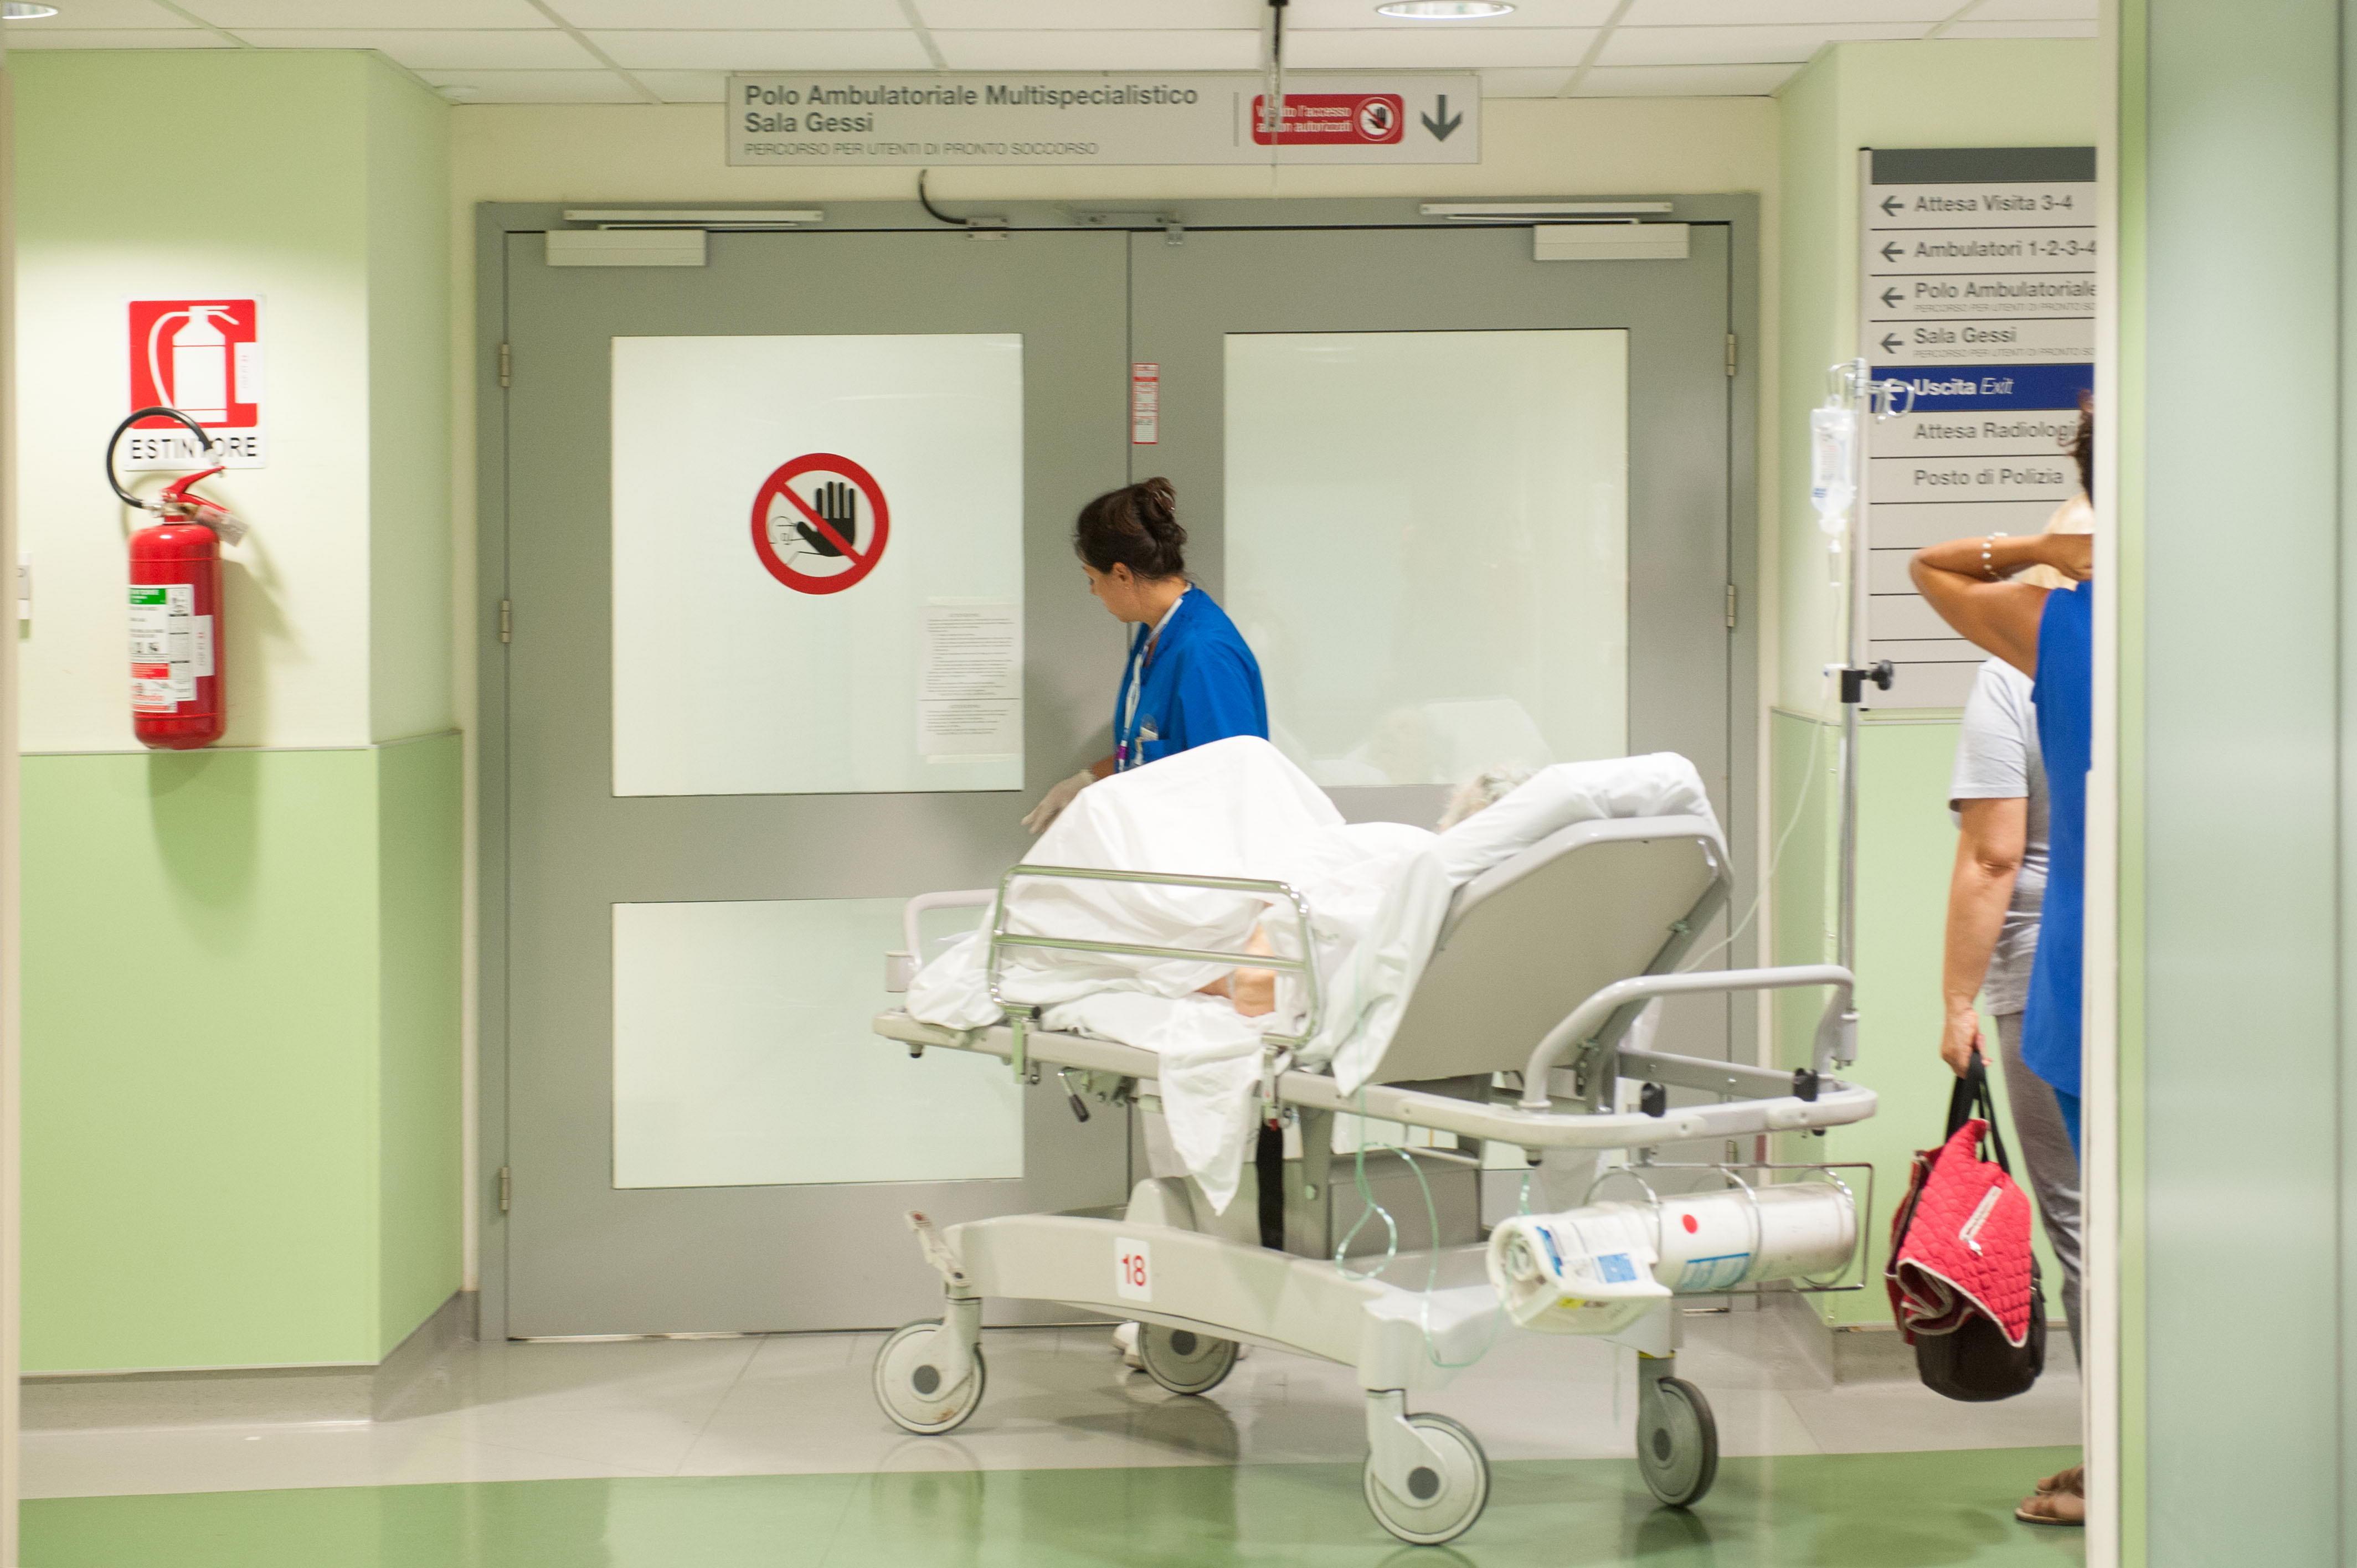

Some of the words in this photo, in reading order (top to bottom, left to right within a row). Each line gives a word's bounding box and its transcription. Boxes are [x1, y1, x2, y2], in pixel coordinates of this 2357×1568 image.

[745, 85, 799, 105] Polo
[806, 85, 978, 105] Ambulatoriale
[985, 85, 1198, 109] Multispecialistico
[745, 112, 797, 132] Sala
[805, 112, 873, 132] Gessi
[744, 143, 829, 156] PERCORSO
[832, 143, 864, 156] PER
[867, 143, 921, 155] UTENTI
[925, 143, 940, 155] DI
[943, 143, 1007, 155] PRONTO
[1010, 142, 1099, 155] SOCCORSO
[1914, 195, 1977, 212] Attesa
[1983, 195, 2036, 211] Visita
[2041, 194, 2073, 210] 3-4
[1914, 240, 2022, 257] Ambulatori
[2029, 240, 2096, 256] 1-2-3-4
[1915, 282, 1959, 298] Polo
[1964, 281, 2096, 297] Ambulatoriale
[1913, 328, 1955, 343] Sala
[1962, 327, 2016, 343] Gessi
[1913, 378, 1977, 395] Uscita
[1980, 378, 2014, 394] Exit
[1914, 423, 1977, 439] Attesa
[1915, 470, 1970, 485] Posto
[1977, 469, 1993, 484] di
[1999, 468, 2063, 484] Polizia
[1122, 1254, 1146, 1286] 18
